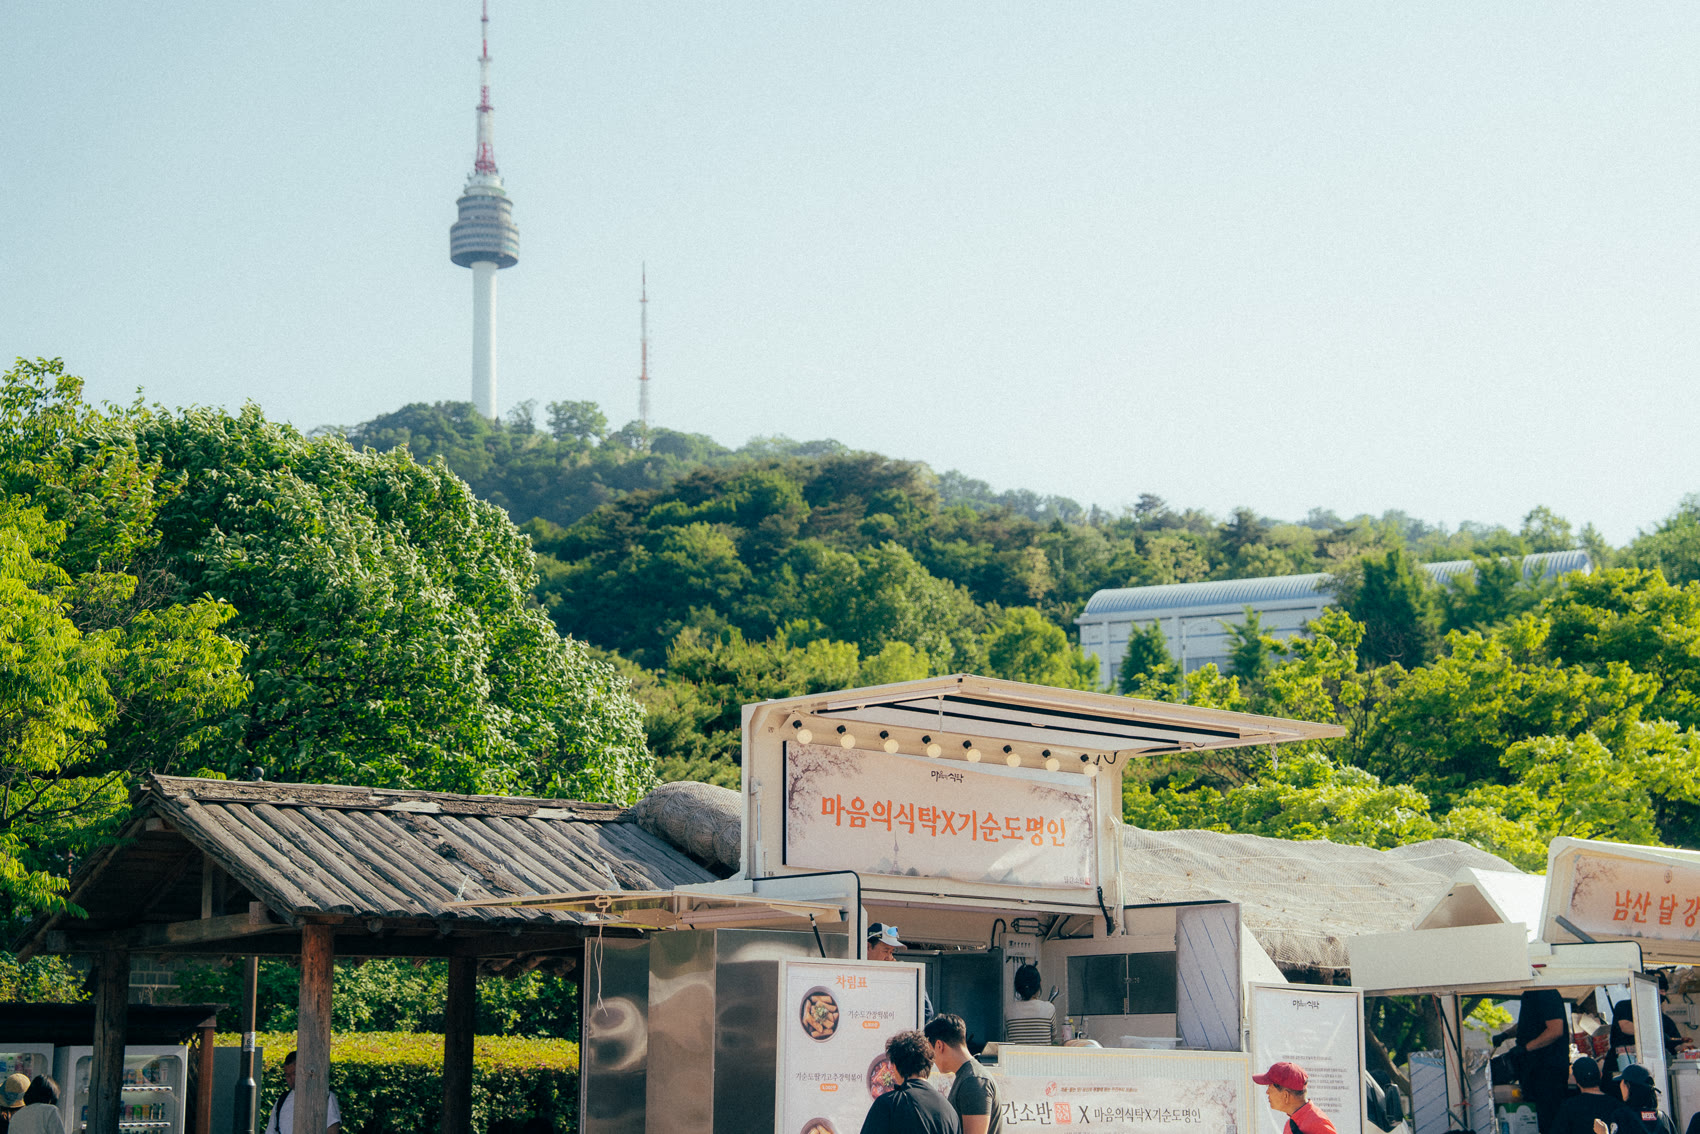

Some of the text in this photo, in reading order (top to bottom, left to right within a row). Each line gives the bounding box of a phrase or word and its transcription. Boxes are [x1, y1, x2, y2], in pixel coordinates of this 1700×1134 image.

[821, 794, 1066, 847] 마음의식탁X기순도명인
[835, 974, 868, 989] 차림표
[1094, 1106, 1202, 1124] 마음의식탁X기순도명인
